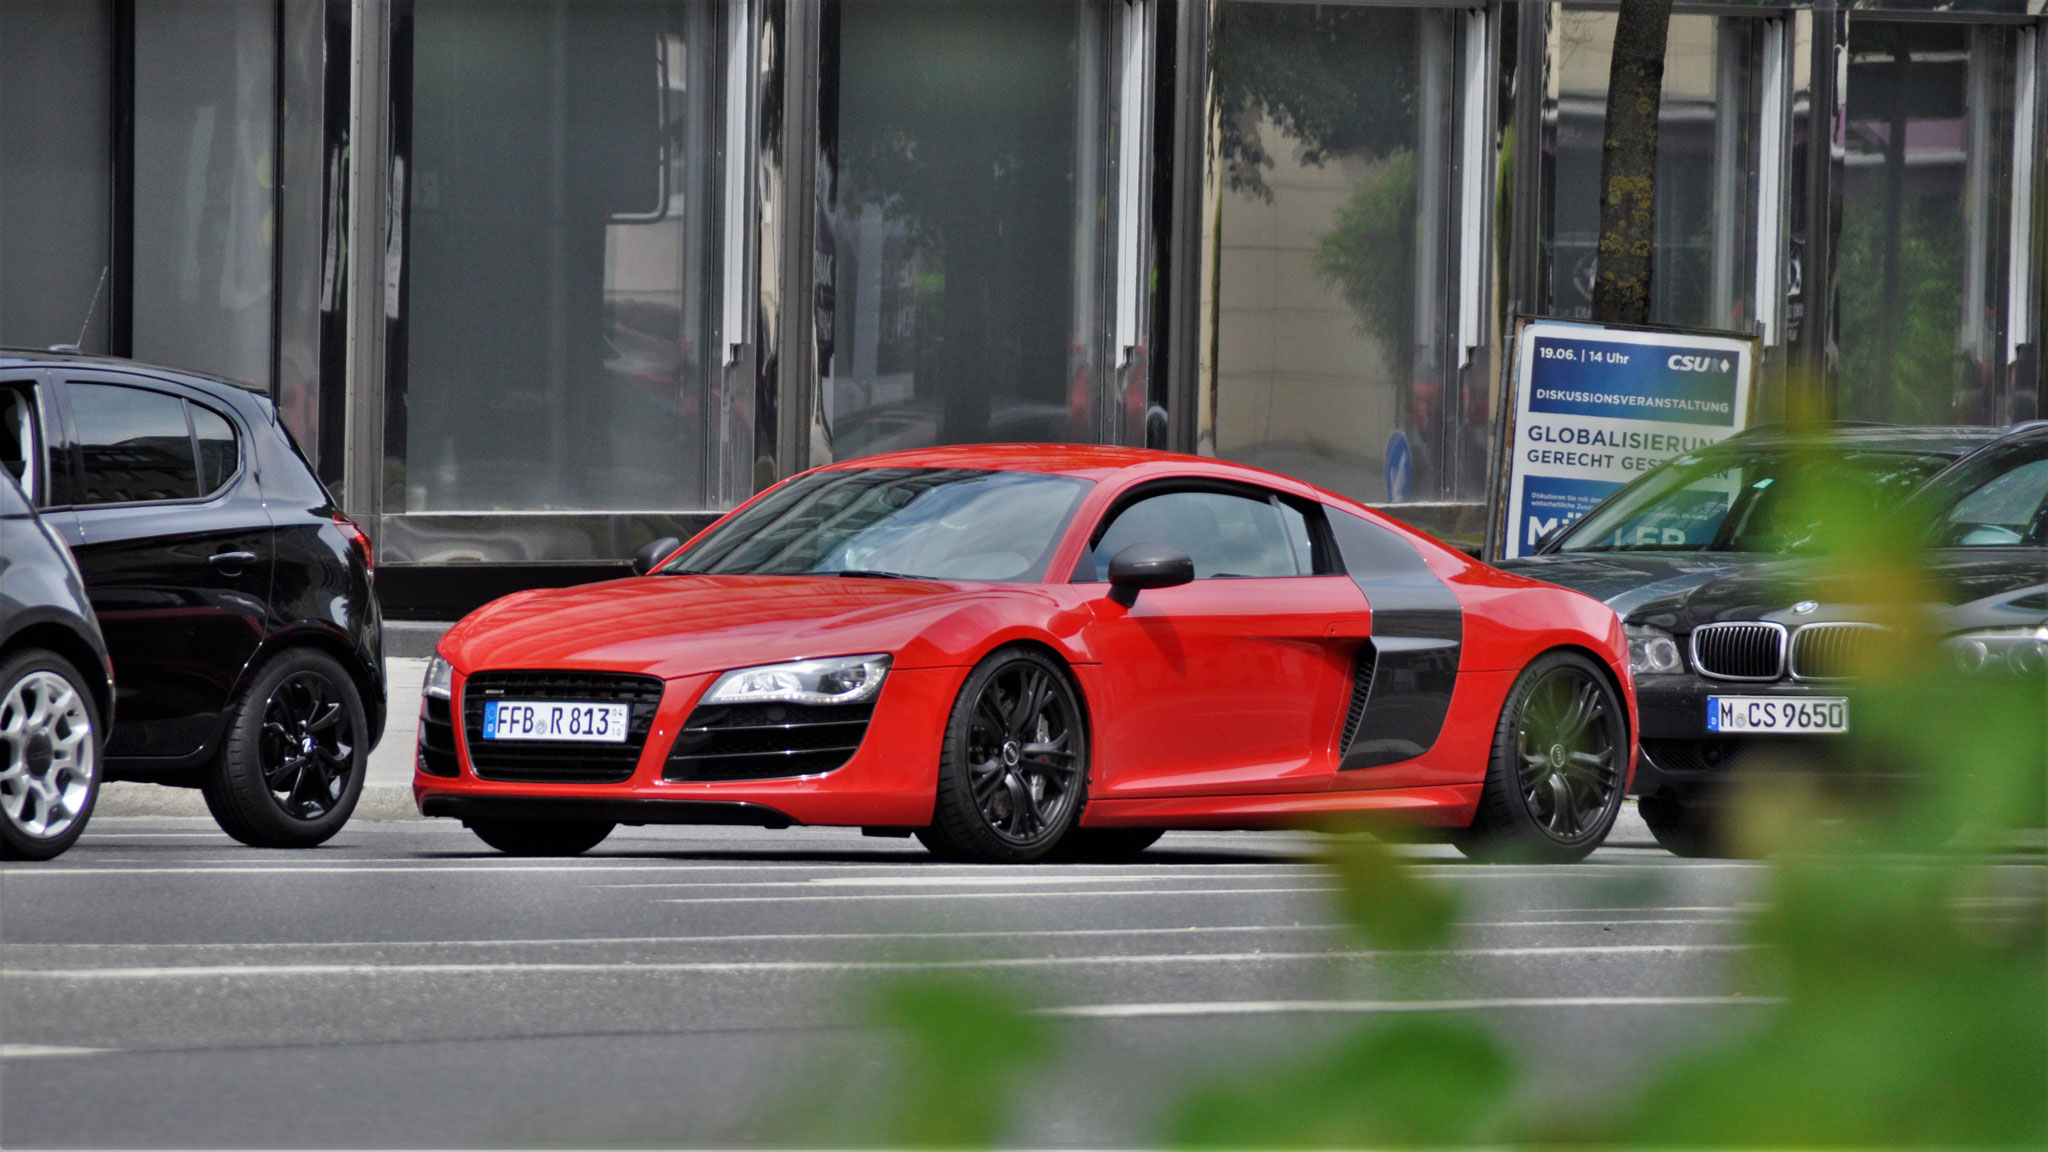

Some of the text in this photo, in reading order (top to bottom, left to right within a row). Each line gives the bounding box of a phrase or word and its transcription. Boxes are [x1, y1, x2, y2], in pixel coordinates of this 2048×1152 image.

[1540, 347, 1577, 360] 19.06.
[1589, 351, 1603, 362] 14
[1606, 352, 1629, 364] Uhr
[1667, 354, 1711, 372] CSU
[1536, 389, 1729, 413] DISKUSSIONSVERANSTALTUNG
[1528, 425, 1714, 454] GLOBALISIERUN
[1527, 449, 1614, 468] GERECHT
[1531, 492, 1566, 501] Diskutieren
[1531, 500, 1575, 509] wirtschaftliche
[497, 706, 610, 735] FFB R 813
[1721, 702, 1843, 728] M CS 9650
